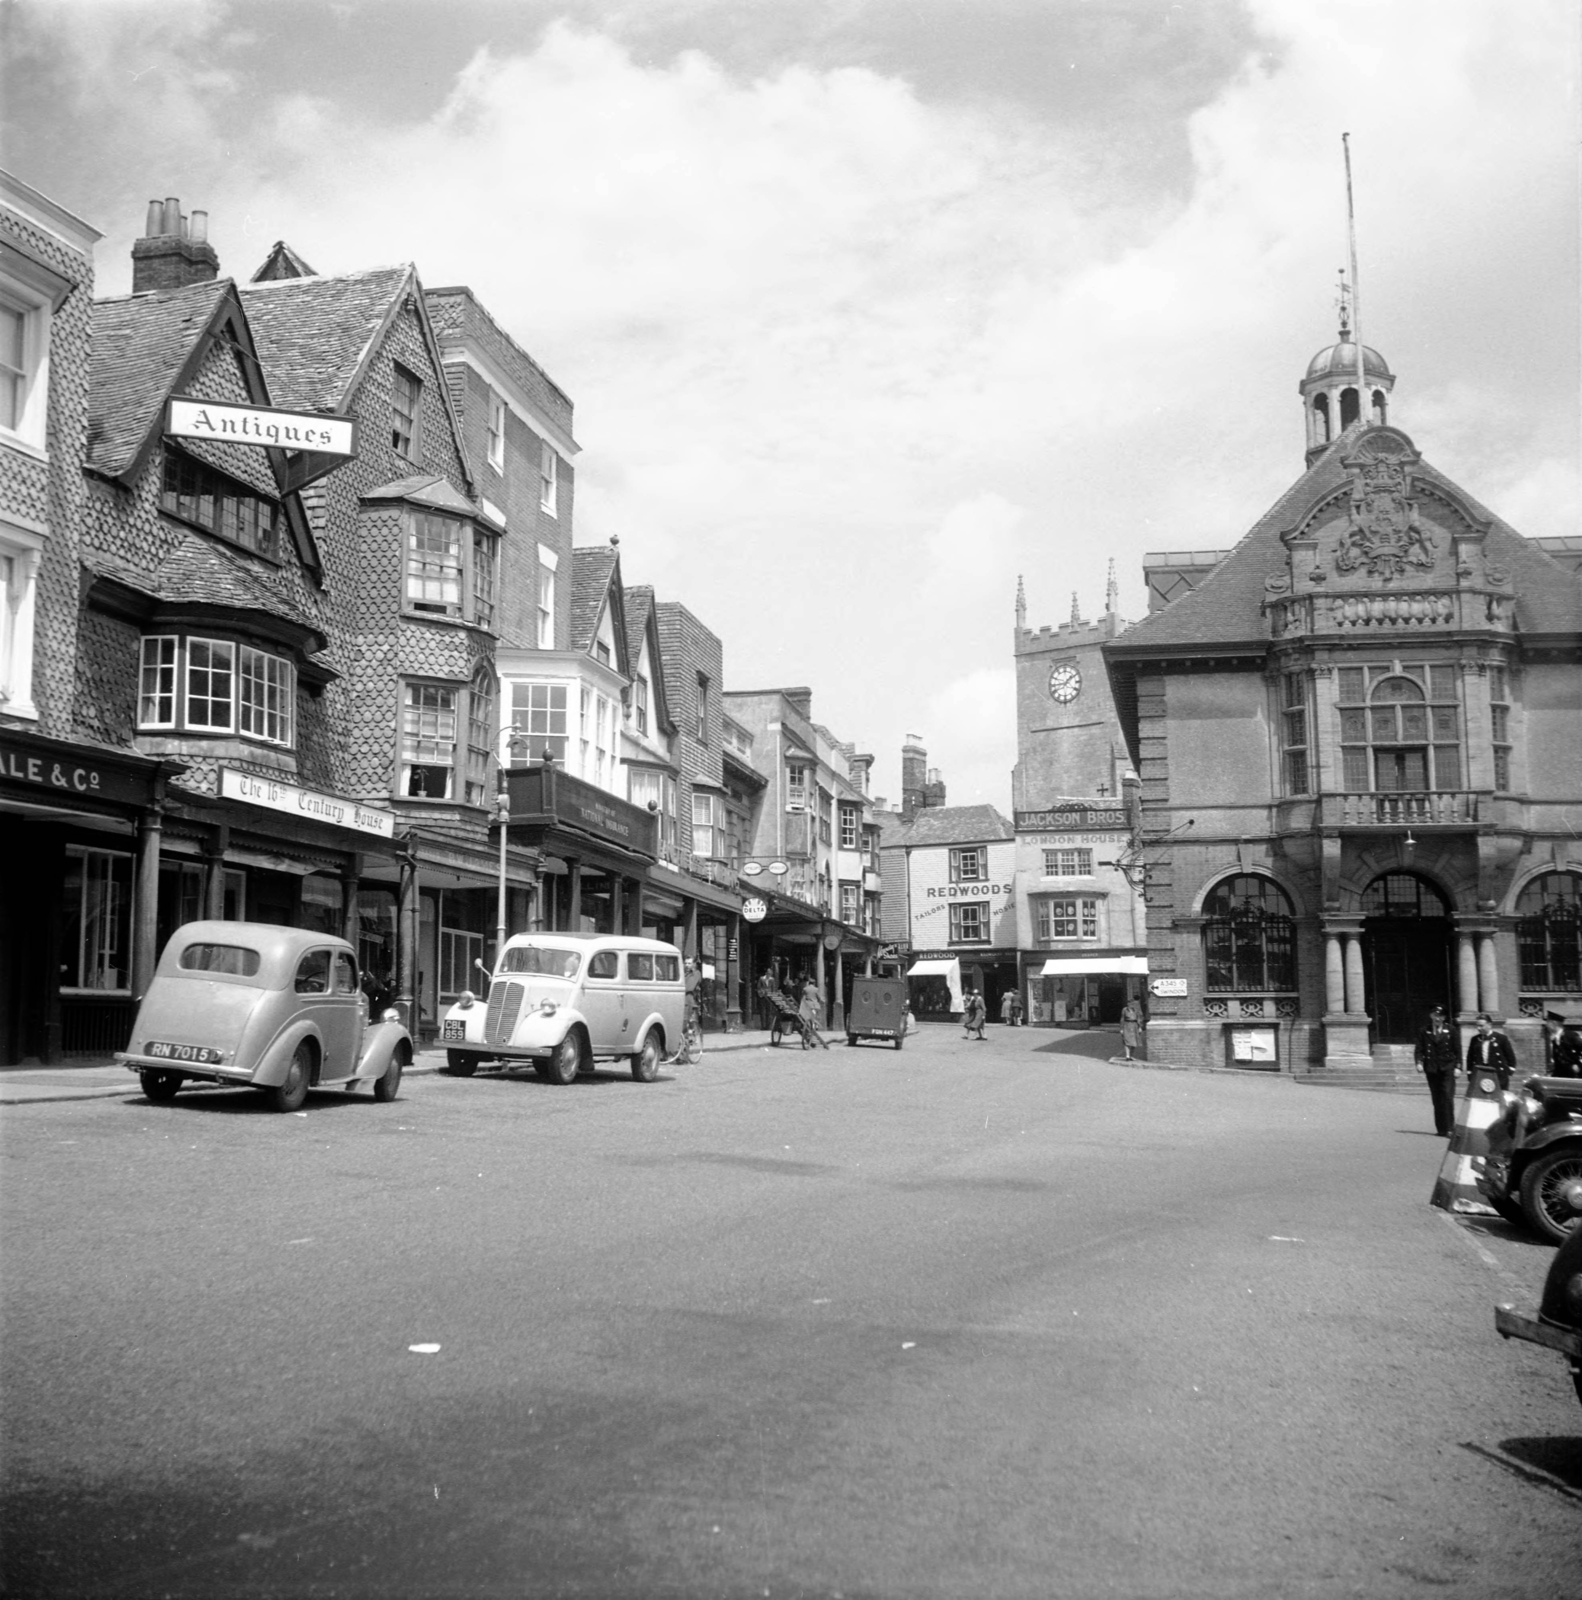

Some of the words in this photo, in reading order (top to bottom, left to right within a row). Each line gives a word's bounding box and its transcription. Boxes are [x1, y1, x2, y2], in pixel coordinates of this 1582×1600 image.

[192, 409, 332, 446] Antiques
[51, 763, 68, 788] &
[239, 774, 262, 799] The
[267, 781, 288, 802] 16th
[298, 791, 345, 824] Century
[353, 803, 384, 829] House
[580, 807, 604, 827] NATIONAL
[605, 818, 629, 837] INSURANCE
[1020, 812, 1081, 826] JACKSON
[1023, 835, 1076, 845] LONDON
[926, 884, 1013, 898] REDWOODS
[914, 904, 946, 921] TAILORS
[445, 1020, 464, 1030] CBL
[445, 1029, 464, 1039] 859
[151, 1043, 171, 1057] RN
[173, 1045, 210, 1061] 7015
